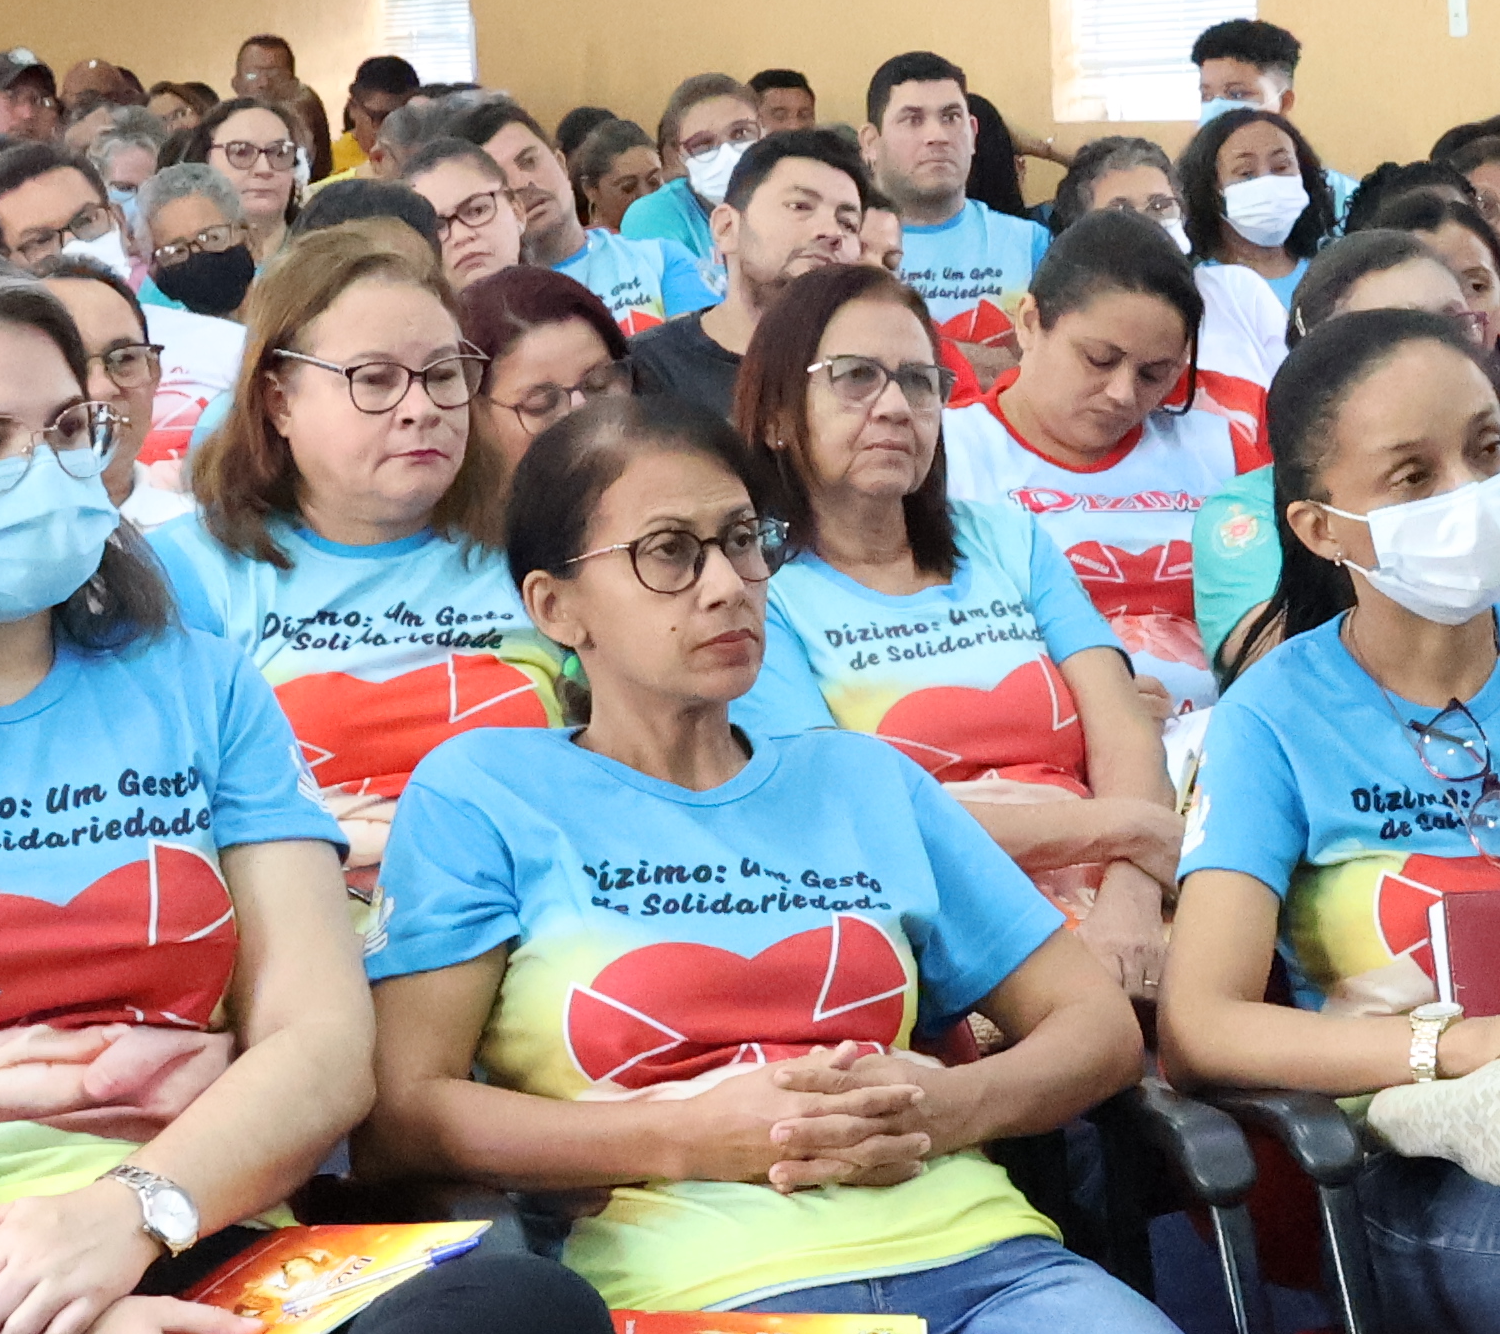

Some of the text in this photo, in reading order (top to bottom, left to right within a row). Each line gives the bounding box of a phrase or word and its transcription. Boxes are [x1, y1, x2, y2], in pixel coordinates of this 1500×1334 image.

[949, 606, 989, 626] Um
[850, 650, 881, 672] de
[45, 783, 108, 815] Um
[117, 766, 199, 798] Gesto
[1379, 817, 1413, 840] de
[739, 857, 792, 884] Um
